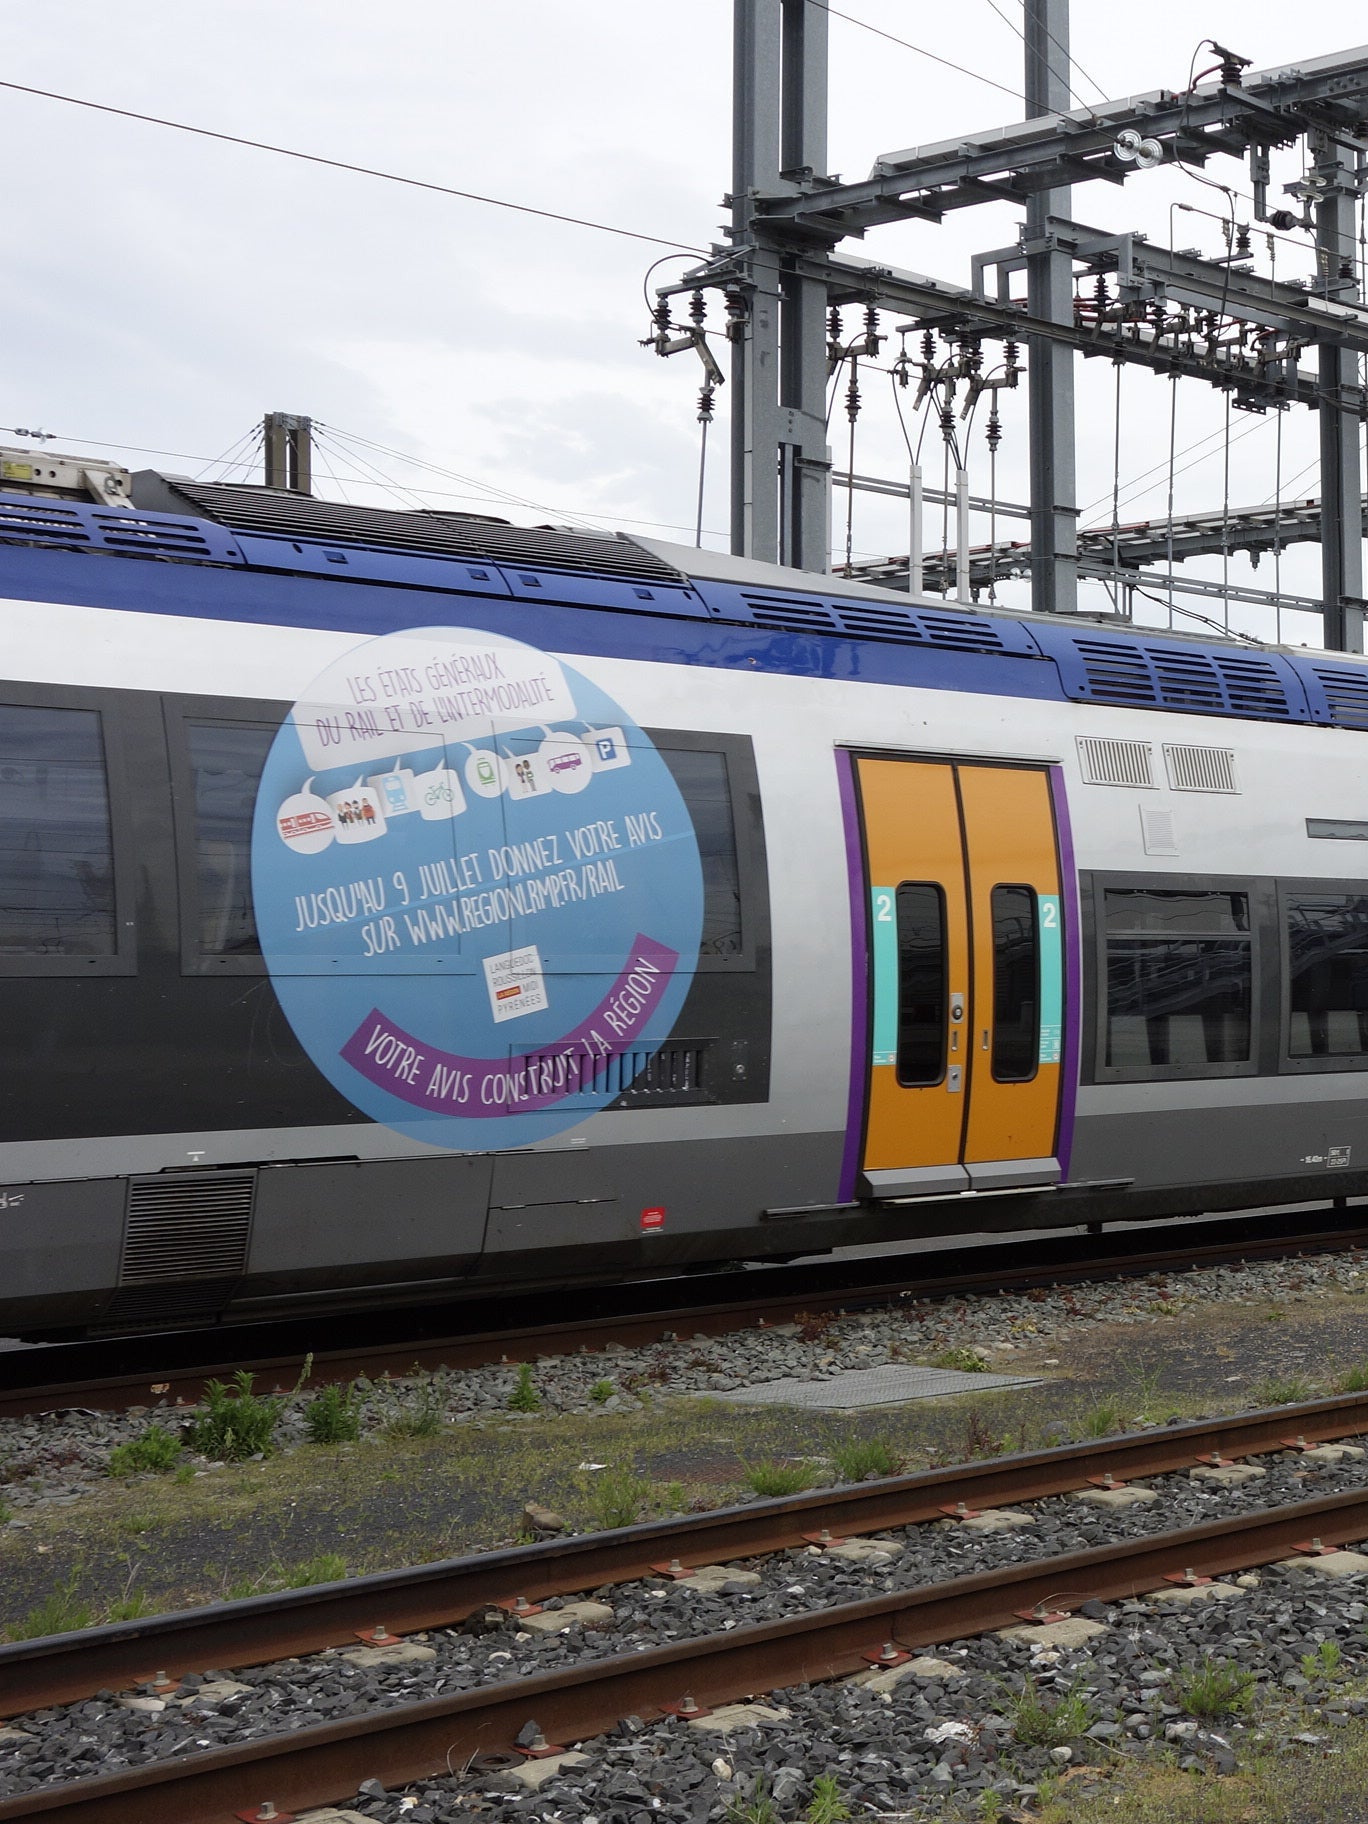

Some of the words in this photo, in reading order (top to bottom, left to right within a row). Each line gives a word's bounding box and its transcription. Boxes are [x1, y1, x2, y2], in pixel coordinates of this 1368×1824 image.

[347, 676, 377, 704] LES
[377, 666, 423, 698] ÉTATS
[425, 652, 505, 690] GÉNÉRAUX
[316, 716, 341, 747] DU
[345, 709, 384, 741] RAIL
[384, 705, 405, 731] ET
[409, 700, 433, 728] DE
[295, 877, 385, 931] JUSQU'AU
[393, 872, 410, 905] 9
[418, 853, 483, 899] JUILLET
[488, 835, 564, 881] DONNEZ
[565, 820, 622, 860] VOTRE
[624, 812, 662, 848] AVIS
[877, 894, 893, 921] 2
[1043, 902, 1056, 928] 2
[361, 917, 400, 957] SUR
[364, 1024, 425, 1085] VOTRE
[426, 1063, 473, 1103] AVIS
[581, 1029, 613, 1060] LA
[603, 957, 661, 1037] RÉGION
